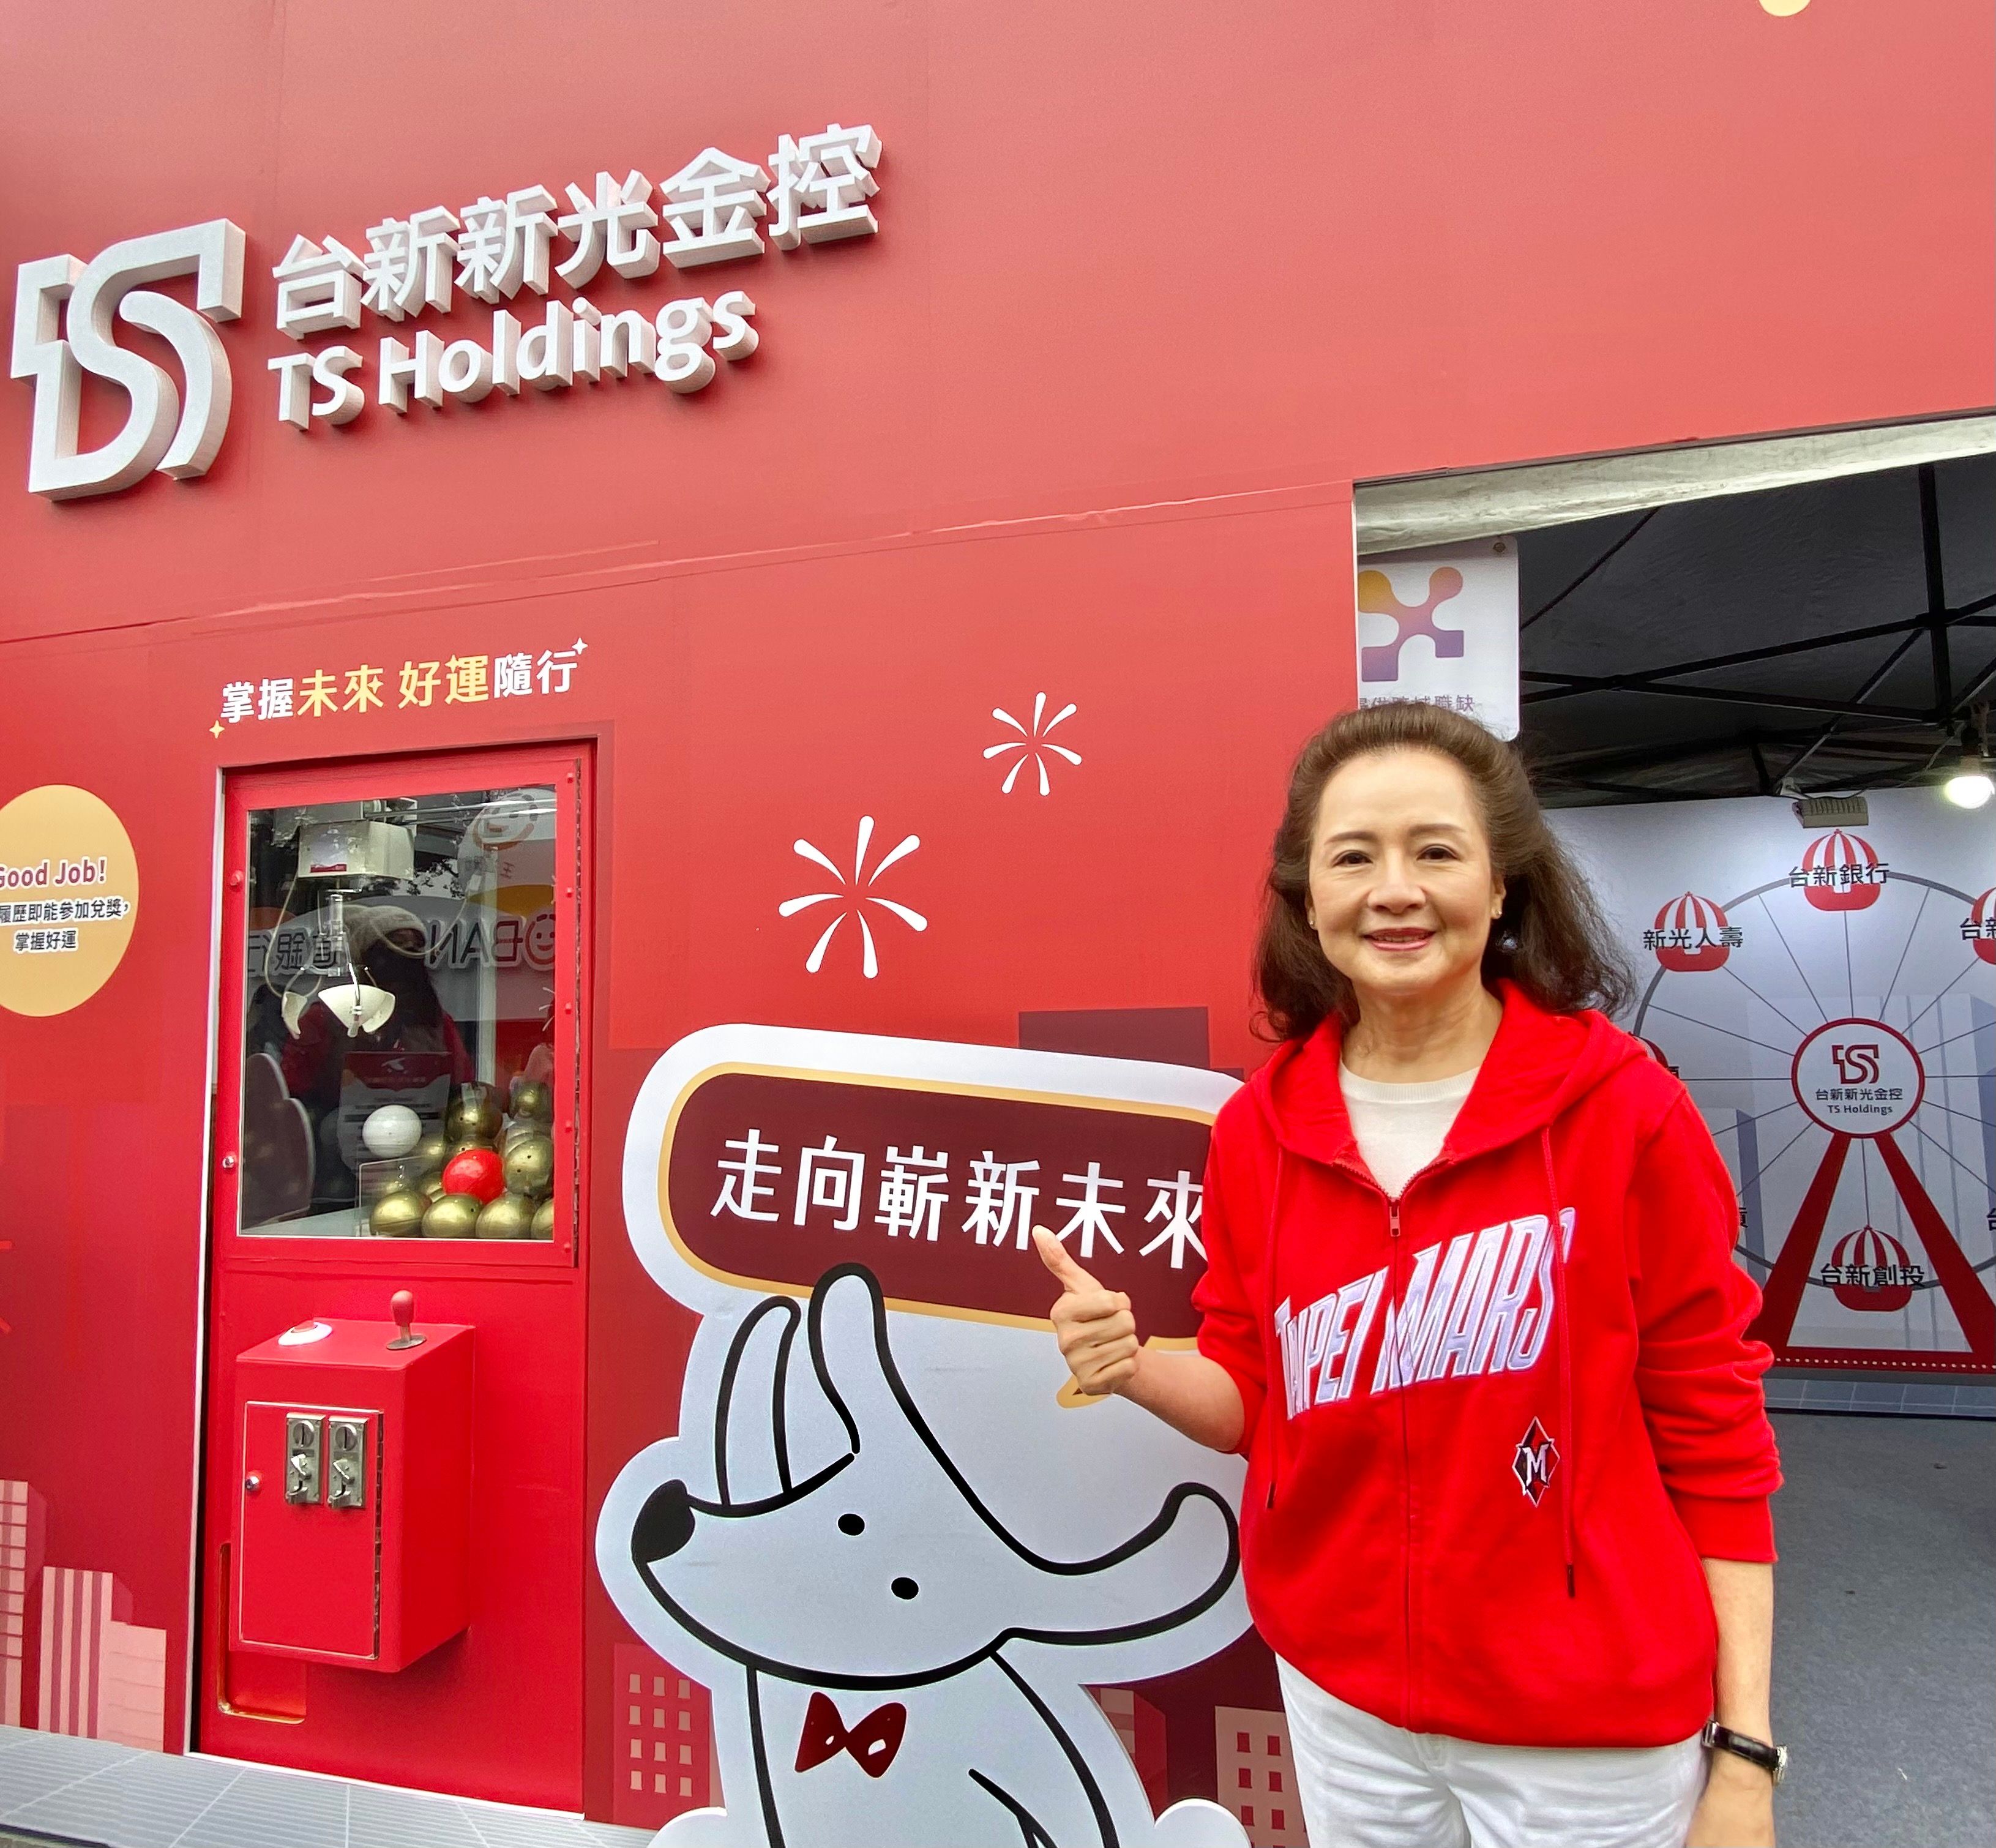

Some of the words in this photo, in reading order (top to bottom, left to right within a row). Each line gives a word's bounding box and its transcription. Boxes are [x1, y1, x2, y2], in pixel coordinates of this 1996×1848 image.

[272, 124, 882, 342] 台新新光金控
[267, 345, 365, 430] TS
[379, 290, 759, 414] Holdings
[220, 664, 384, 724] 掌握未來
[398, 649, 578, 709] 好運隨行
[55, 859, 105, 884] Job!
[1788, 862, 1890, 888] 台新銀行
[15, 930, 77, 951] 掌握好運
[1642, 926, 1744, 951] 新光人壽
[1815, 1088, 1903, 1101] 台新新光金控
[1827, 1104, 1841, 1113] TS
[1844, 1104, 1893, 1115] Holdings
[711, 1129, 1207, 1269] 走向嶄新未來
[1820, 1263, 1925, 1288] 台新創投
[1370, 1207, 1575, 1396] MARS
[1520, 1442, 1551, 1487] M
